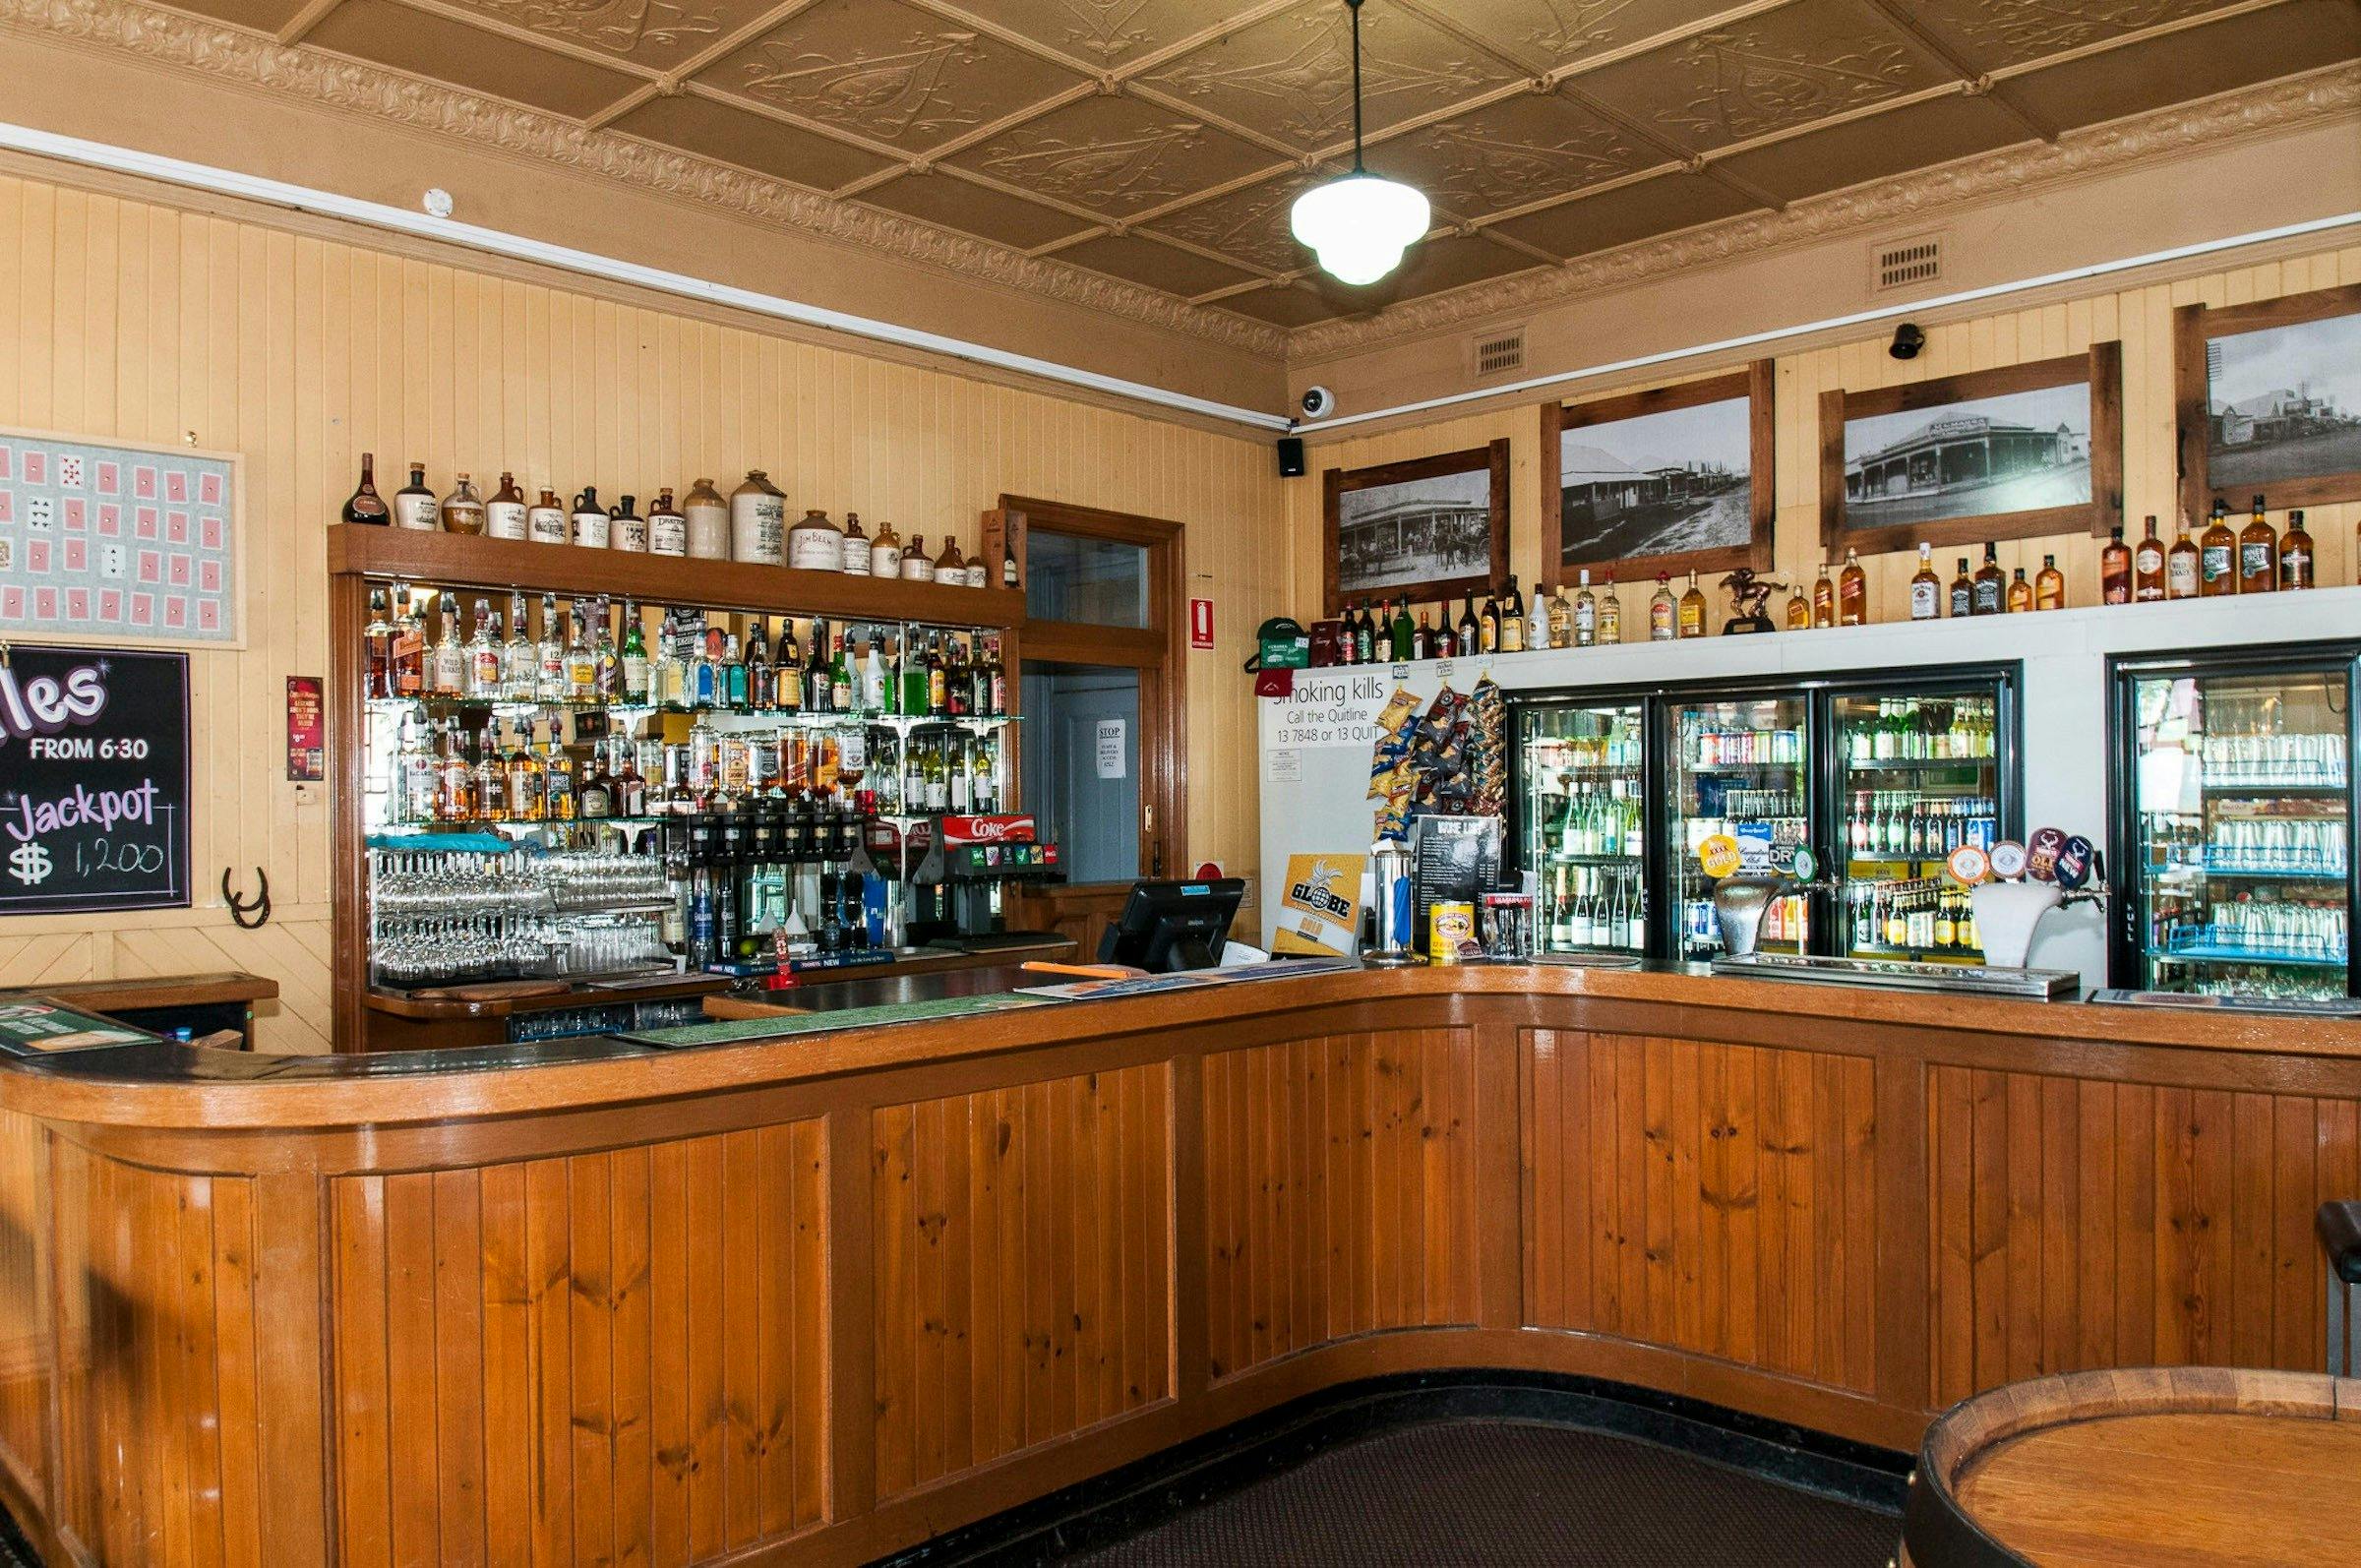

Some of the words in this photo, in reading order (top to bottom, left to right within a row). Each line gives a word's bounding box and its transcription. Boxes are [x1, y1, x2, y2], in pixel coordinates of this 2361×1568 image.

[1353, 676, 1384, 699] kills
[1287, 710, 1304, 724] Call
[1307, 709, 1324, 723] the
[1328, 707, 1367, 723] Quitline
[1099, 727, 1120, 736] STOP
[1278, 730, 1289, 743] 13
[1293, 728, 1317, 742] 7848
[1321, 729, 1333, 741] or
[1338, 727, 1349, 740] 13
[1352, 726, 1380, 741] QUIT
[30, 738, 94, 760] FROM
[6, 778, 159, 842] Jackpot
[971, 818, 1005, 837] Coke
[8, 842, 53, 885] $
[76, 837, 164, 877] 1,200
[1706, 853, 1737, 869] GOLD
[1291, 882, 1351, 918] GLOBE
